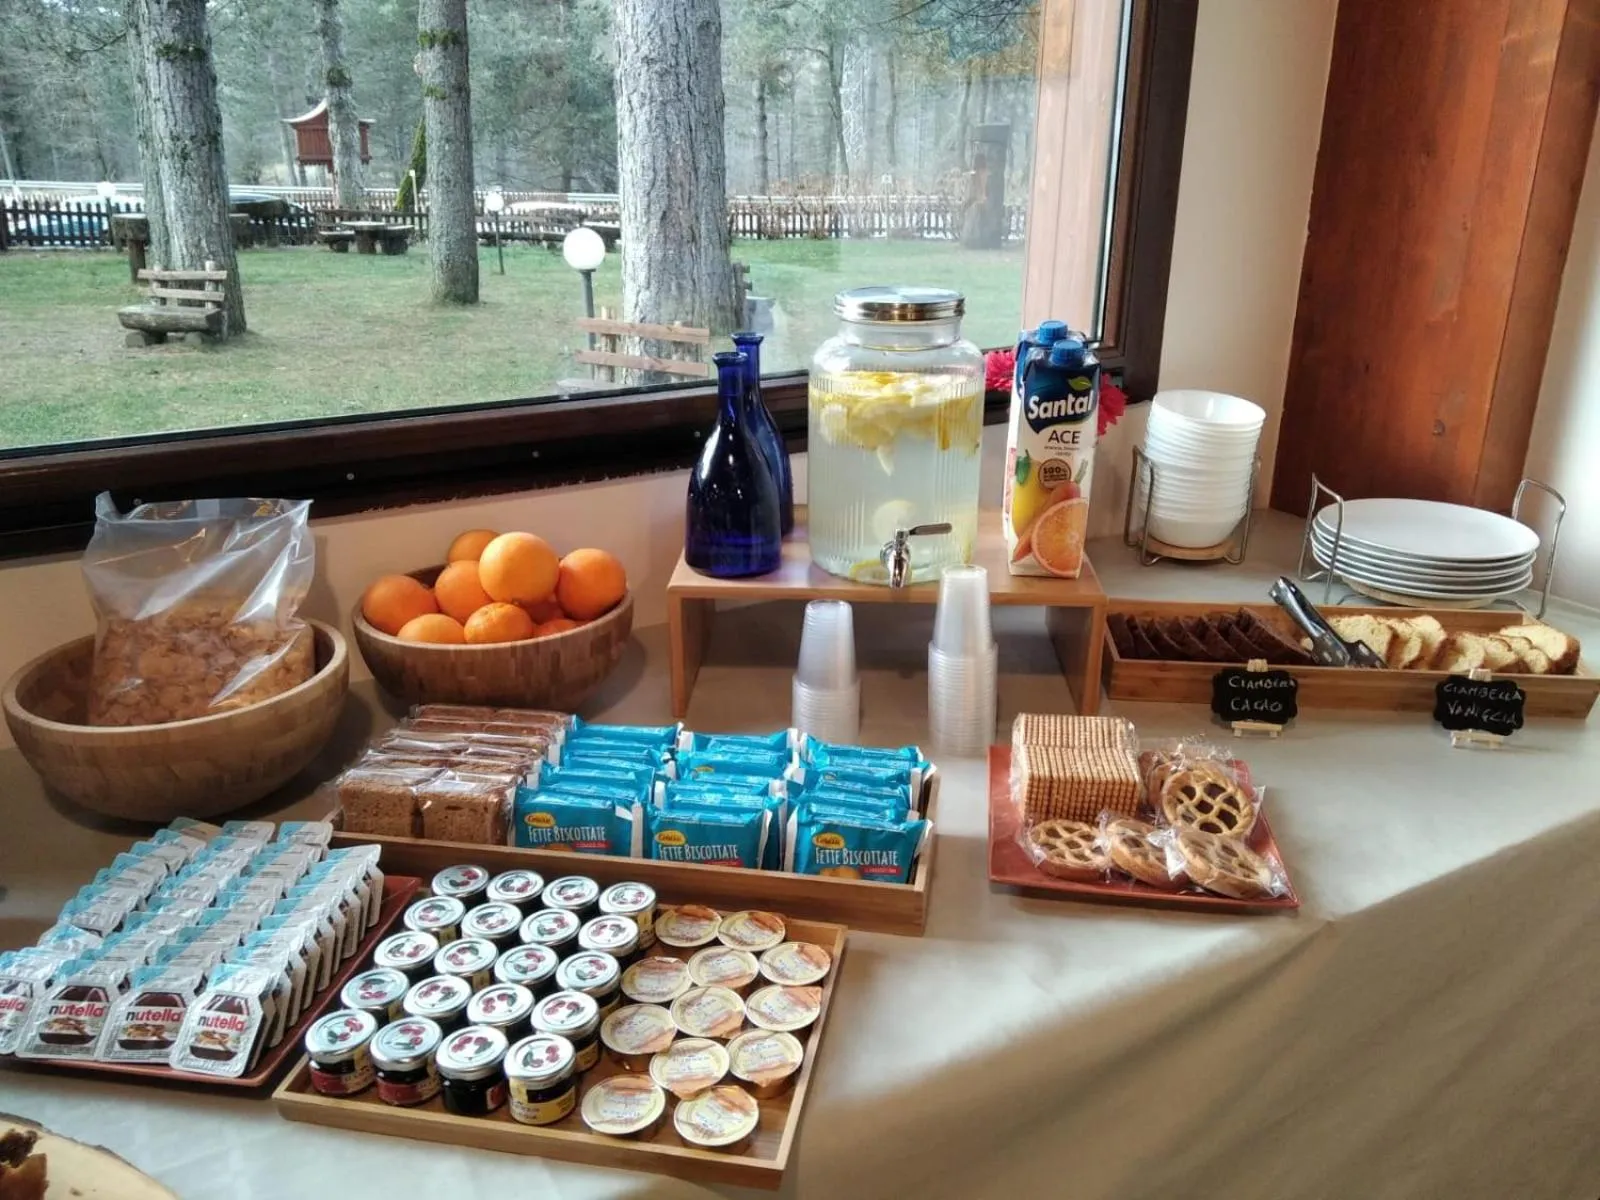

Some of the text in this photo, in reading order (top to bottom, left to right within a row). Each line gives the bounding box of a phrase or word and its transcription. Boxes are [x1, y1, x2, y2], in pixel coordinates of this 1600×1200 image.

[1028, 390, 1093, 420] Santal
[1048, 430, 1081, 444] ACE
[528, 825, 606, 842] FETTE BISCOTTATE
[658, 844, 739, 860] FETTE BISCOTTATE
[815, 847, 899, 866] FETTE BISCOTTATE
[0, 998, 26, 1012] ella
[48, 1002, 105, 1018] nutella
[125, 1008, 183, 1023] nutella
[197, 1014, 248, 1033] nutella
